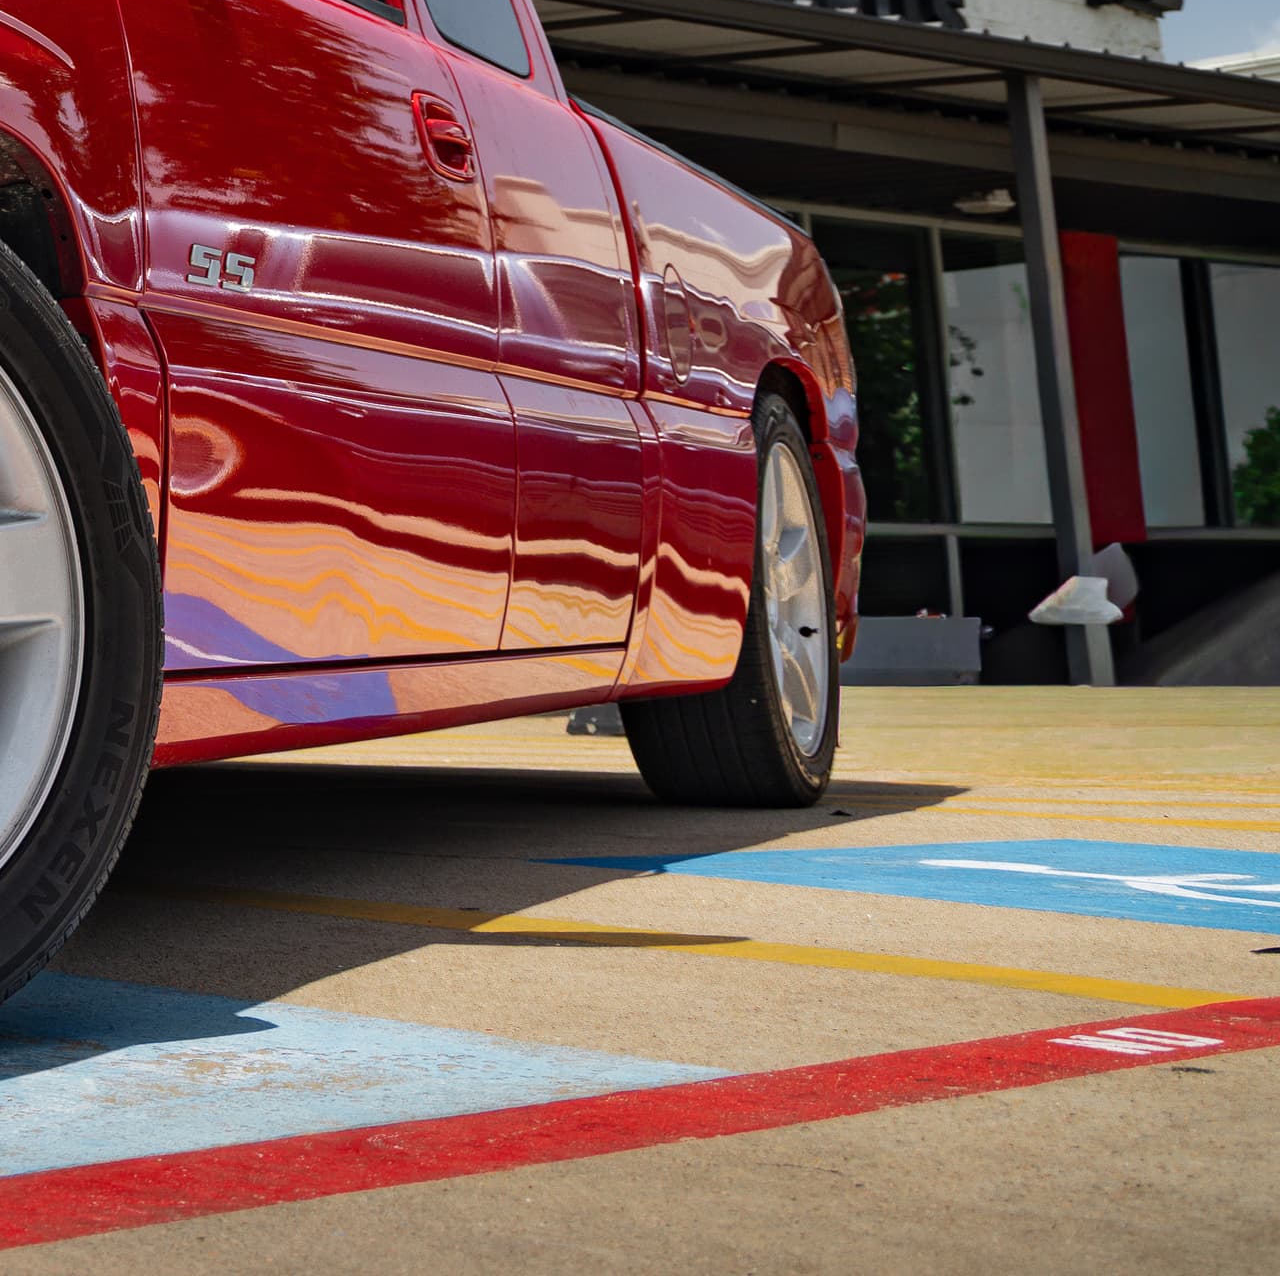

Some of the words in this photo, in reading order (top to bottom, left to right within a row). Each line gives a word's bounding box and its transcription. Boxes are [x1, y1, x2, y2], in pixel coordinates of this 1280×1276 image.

[186, 243, 256, 293] SS
[18, 696, 136, 926] NEXEN
[1046, 1026, 1225, 1055] NO
